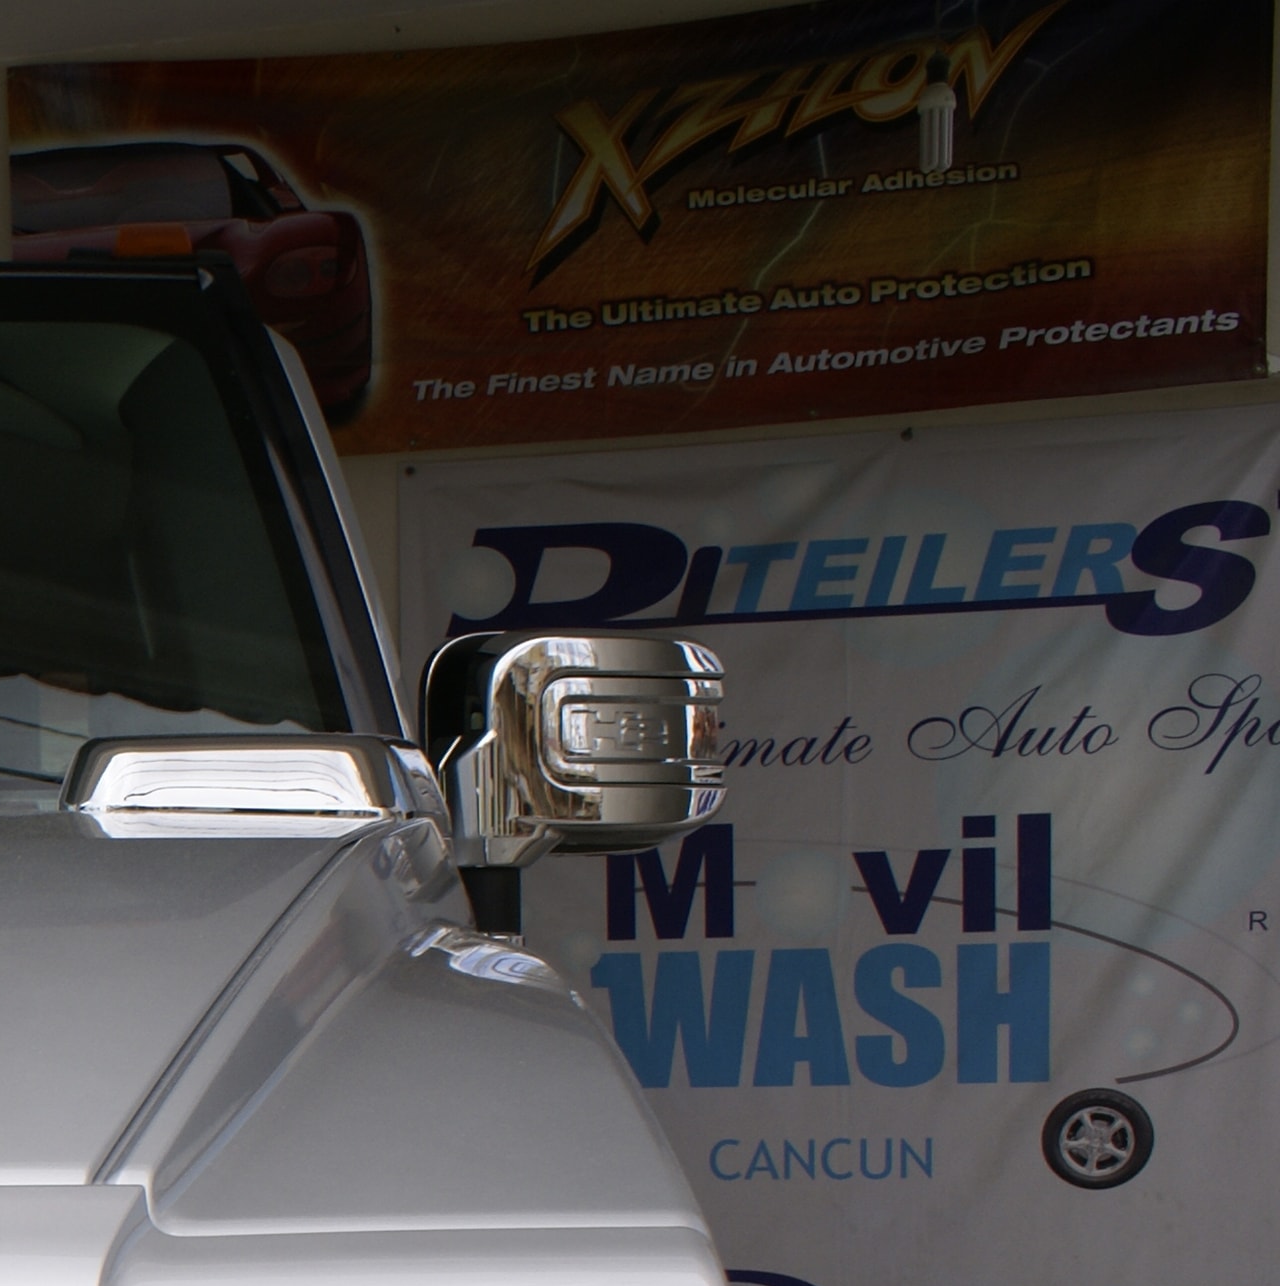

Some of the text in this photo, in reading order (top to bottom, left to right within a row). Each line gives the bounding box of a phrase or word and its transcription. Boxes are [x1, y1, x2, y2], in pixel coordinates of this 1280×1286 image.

[688, 161, 1018, 209] Molecular Adhesion
[523, 256, 1091, 335] The Ultimate Auto Protection
[414, 307, 1239, 402] The Finest Name in Automotive Protectants
[718, 717, 873, 767] mate
[907, 685, 1119, 762] Auto
[591, 941, 1052, 1089] WASH
[709, 1138, 934, 1181] CANCUN
